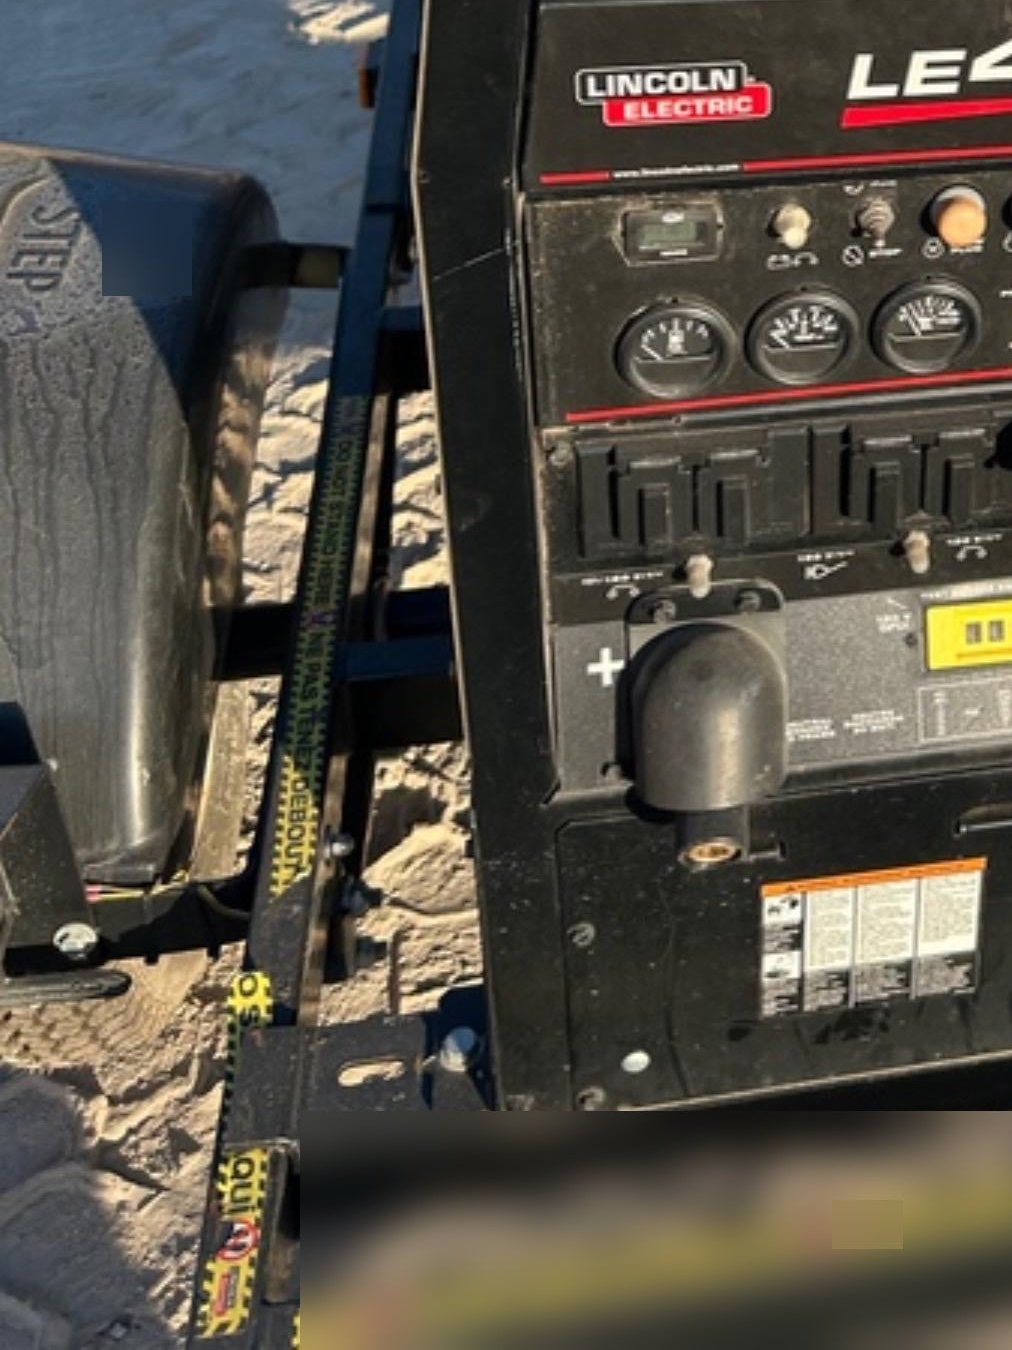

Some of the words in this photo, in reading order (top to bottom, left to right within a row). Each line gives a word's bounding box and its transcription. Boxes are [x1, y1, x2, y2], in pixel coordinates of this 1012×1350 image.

[586, 69, 737, 99] LINCOLN
[623, 96, 754, 121] ELECTRIC
[6, 206, 82, 292] STEP
